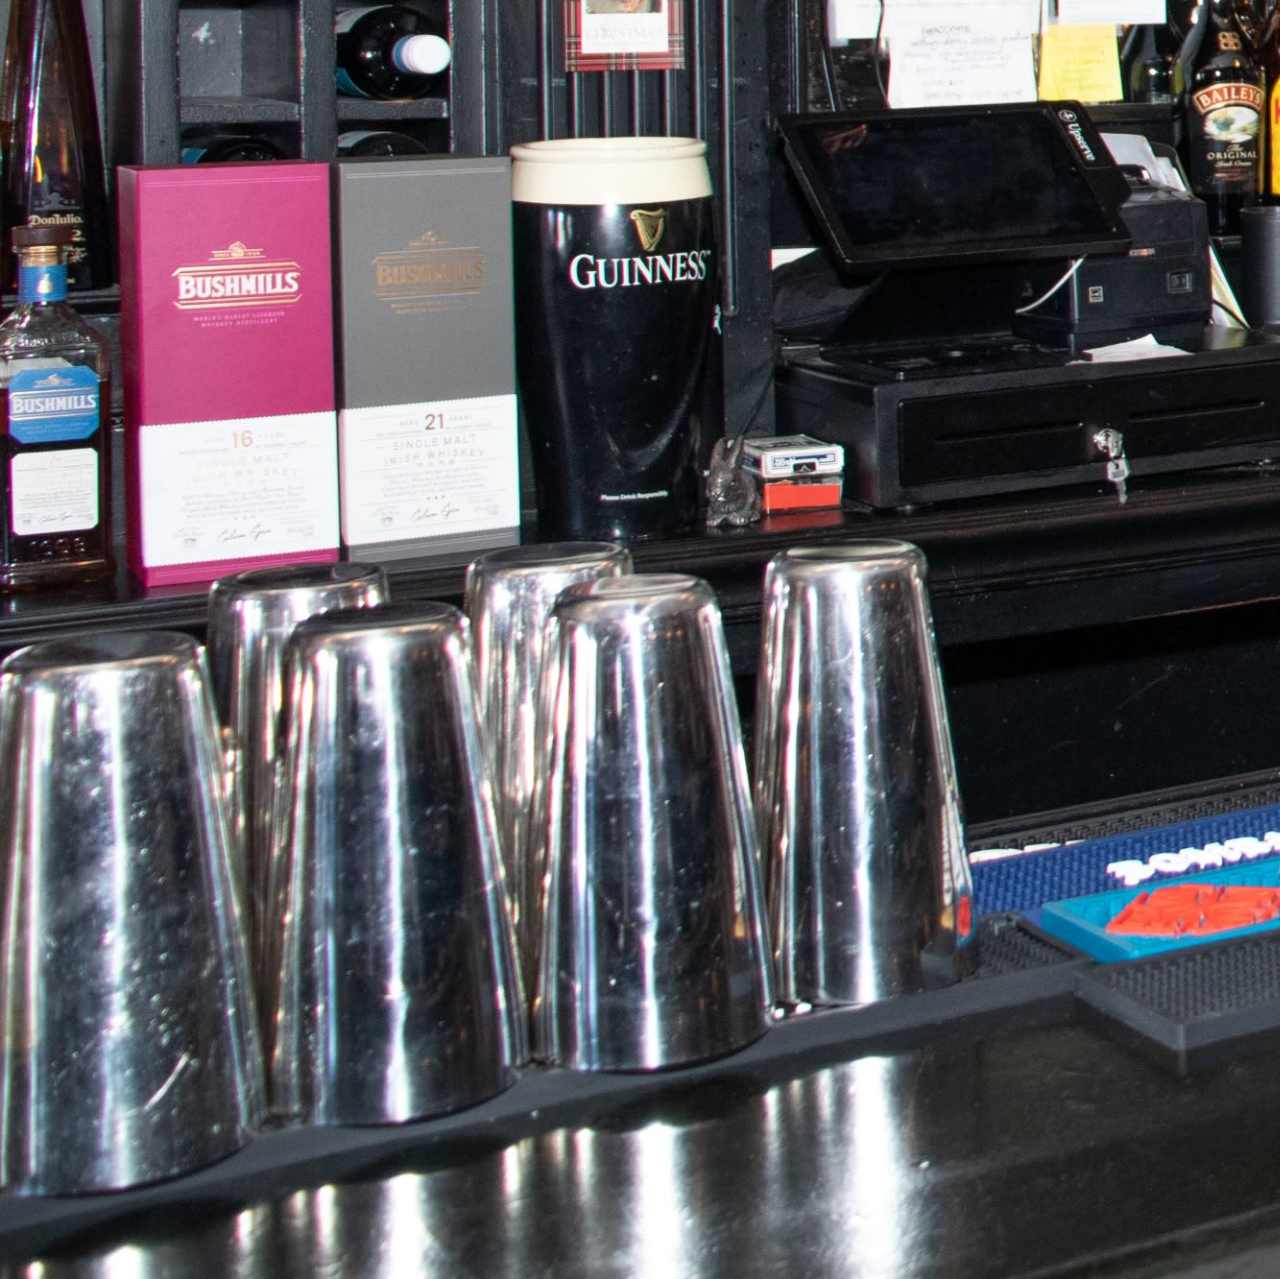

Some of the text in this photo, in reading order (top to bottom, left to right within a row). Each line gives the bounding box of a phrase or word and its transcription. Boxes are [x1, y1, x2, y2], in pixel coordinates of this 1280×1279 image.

[1199, 83, 1264, 108] BAILEYS
[1206, 151, 1258, 161] ORIGINAL
[375, 257, 487, 288] BUSHMILLS
[569, 249, 707, 290] GUINNESS
[177, 271, 301, 301] BUSHMILLS
[11, 394, 98, 416] BUSHMILLS
[425, 413, 446, 431] 21
[232, 430, 254, 449] 16
